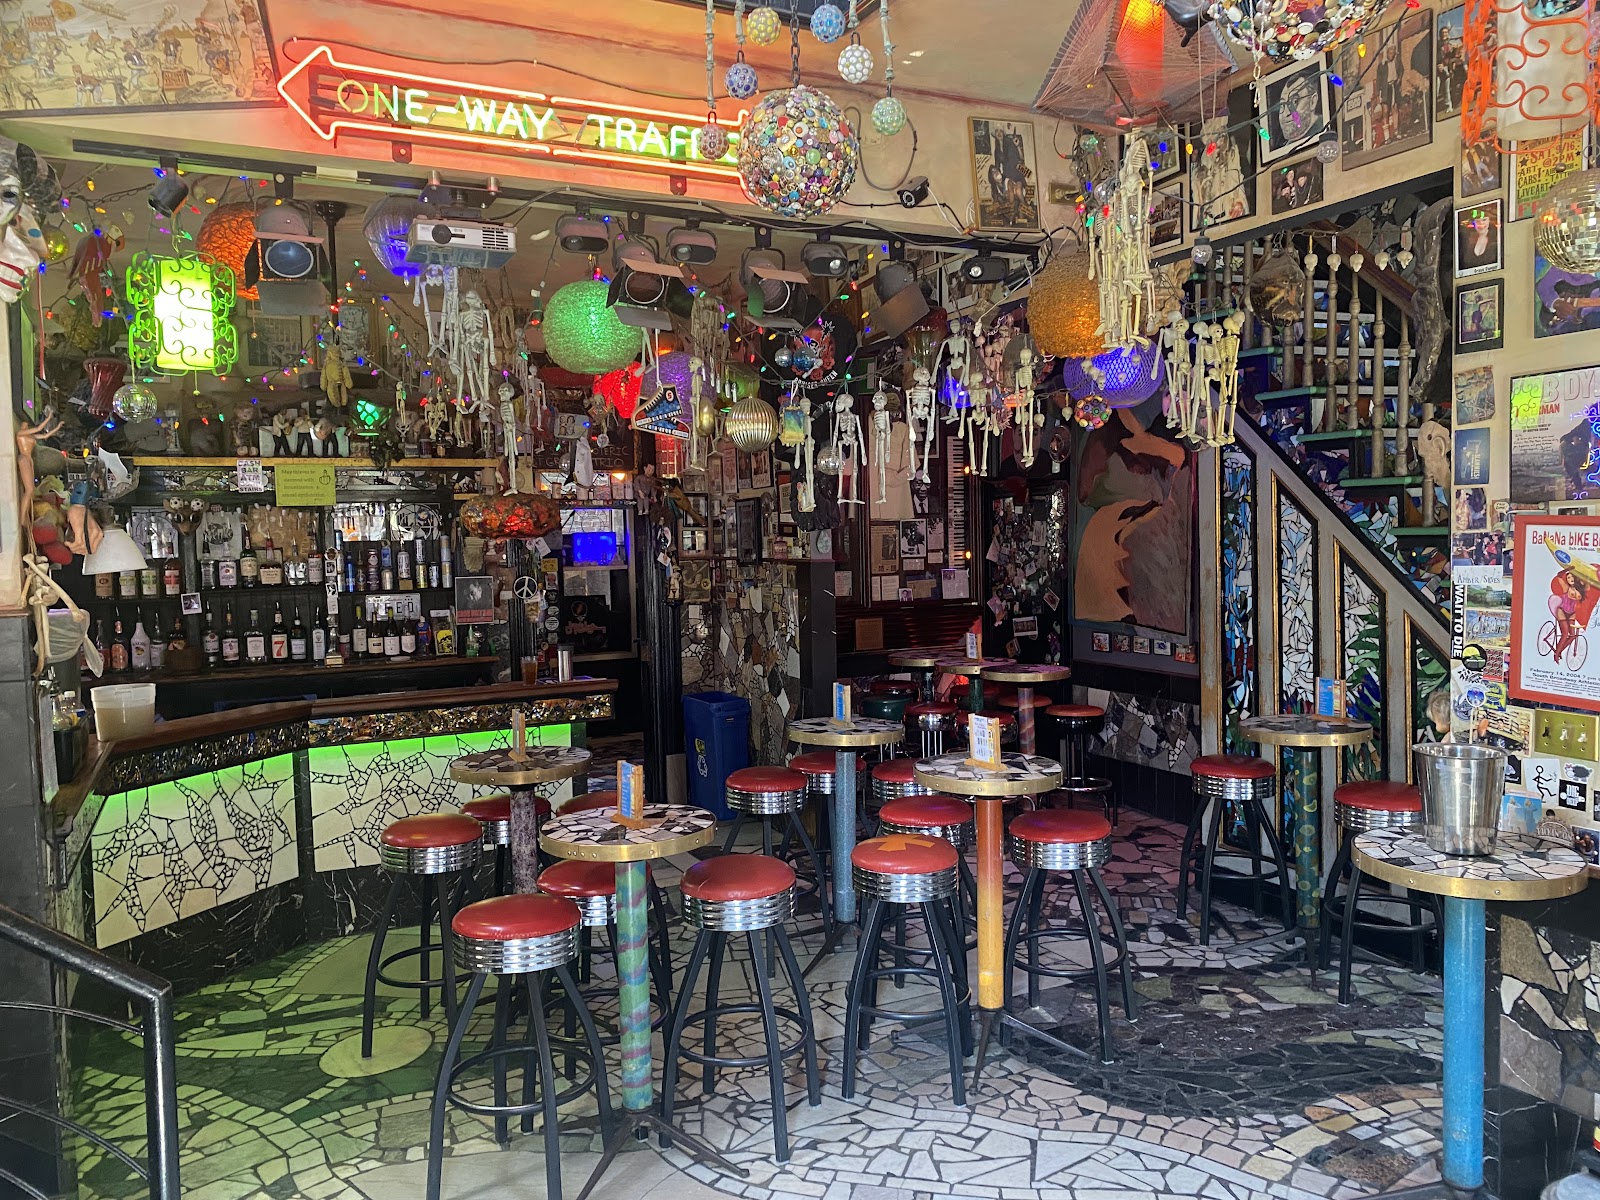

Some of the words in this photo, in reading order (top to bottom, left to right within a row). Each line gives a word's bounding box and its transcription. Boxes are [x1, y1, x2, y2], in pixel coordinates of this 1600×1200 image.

[336, 78, 554, 140] ONE-WAY
[586, 113, 740, 165] TRAFFC
[1518, 168, 1542, 188] CARS!
[1519, 165, 1538, 177] ART
[1454, 584, 1464, 616] WAIT
[1454, 617, 1463, 633] TO
[274, 641, 285, 656] 7
[1454, 636, 1462, 658] DIE
